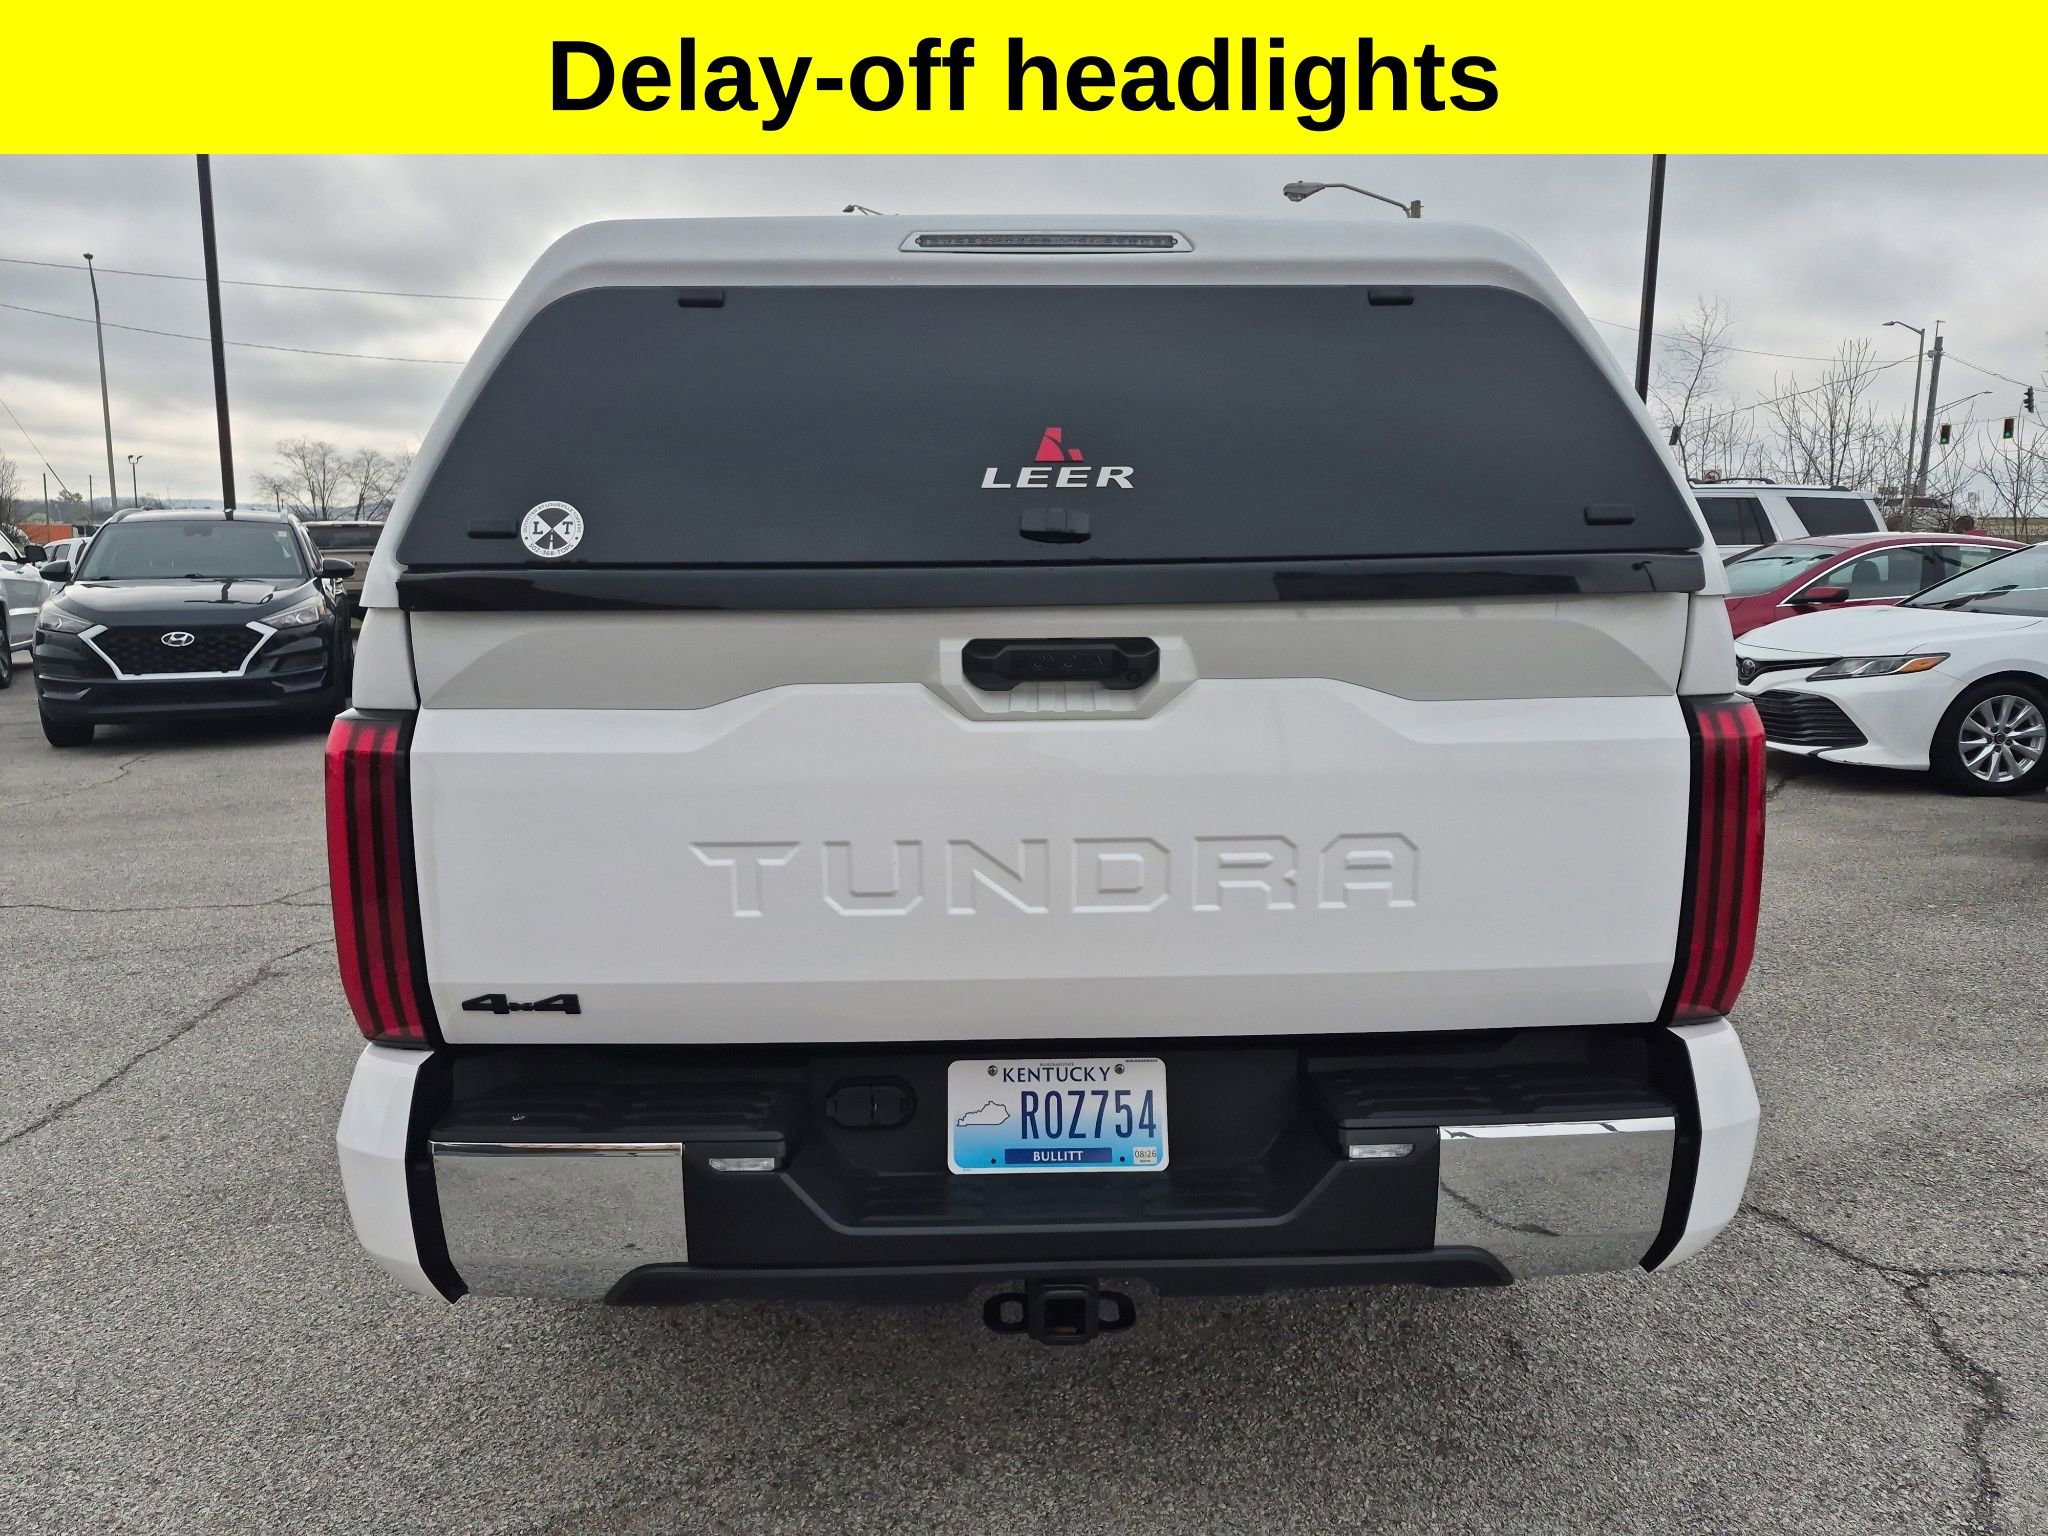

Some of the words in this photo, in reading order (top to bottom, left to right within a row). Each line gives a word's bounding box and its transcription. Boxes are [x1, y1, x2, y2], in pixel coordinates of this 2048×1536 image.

[981, 466, 1134, 489] LEER
[532, 521, 544, 535] L
[562, 521, 573, 535] T
[688, 832, 1419, 918] TUNDRA
[1003, 1066, 1111, 1083] KENTUCKY
[1033, 1150, 1084, 1162] BULLITT
